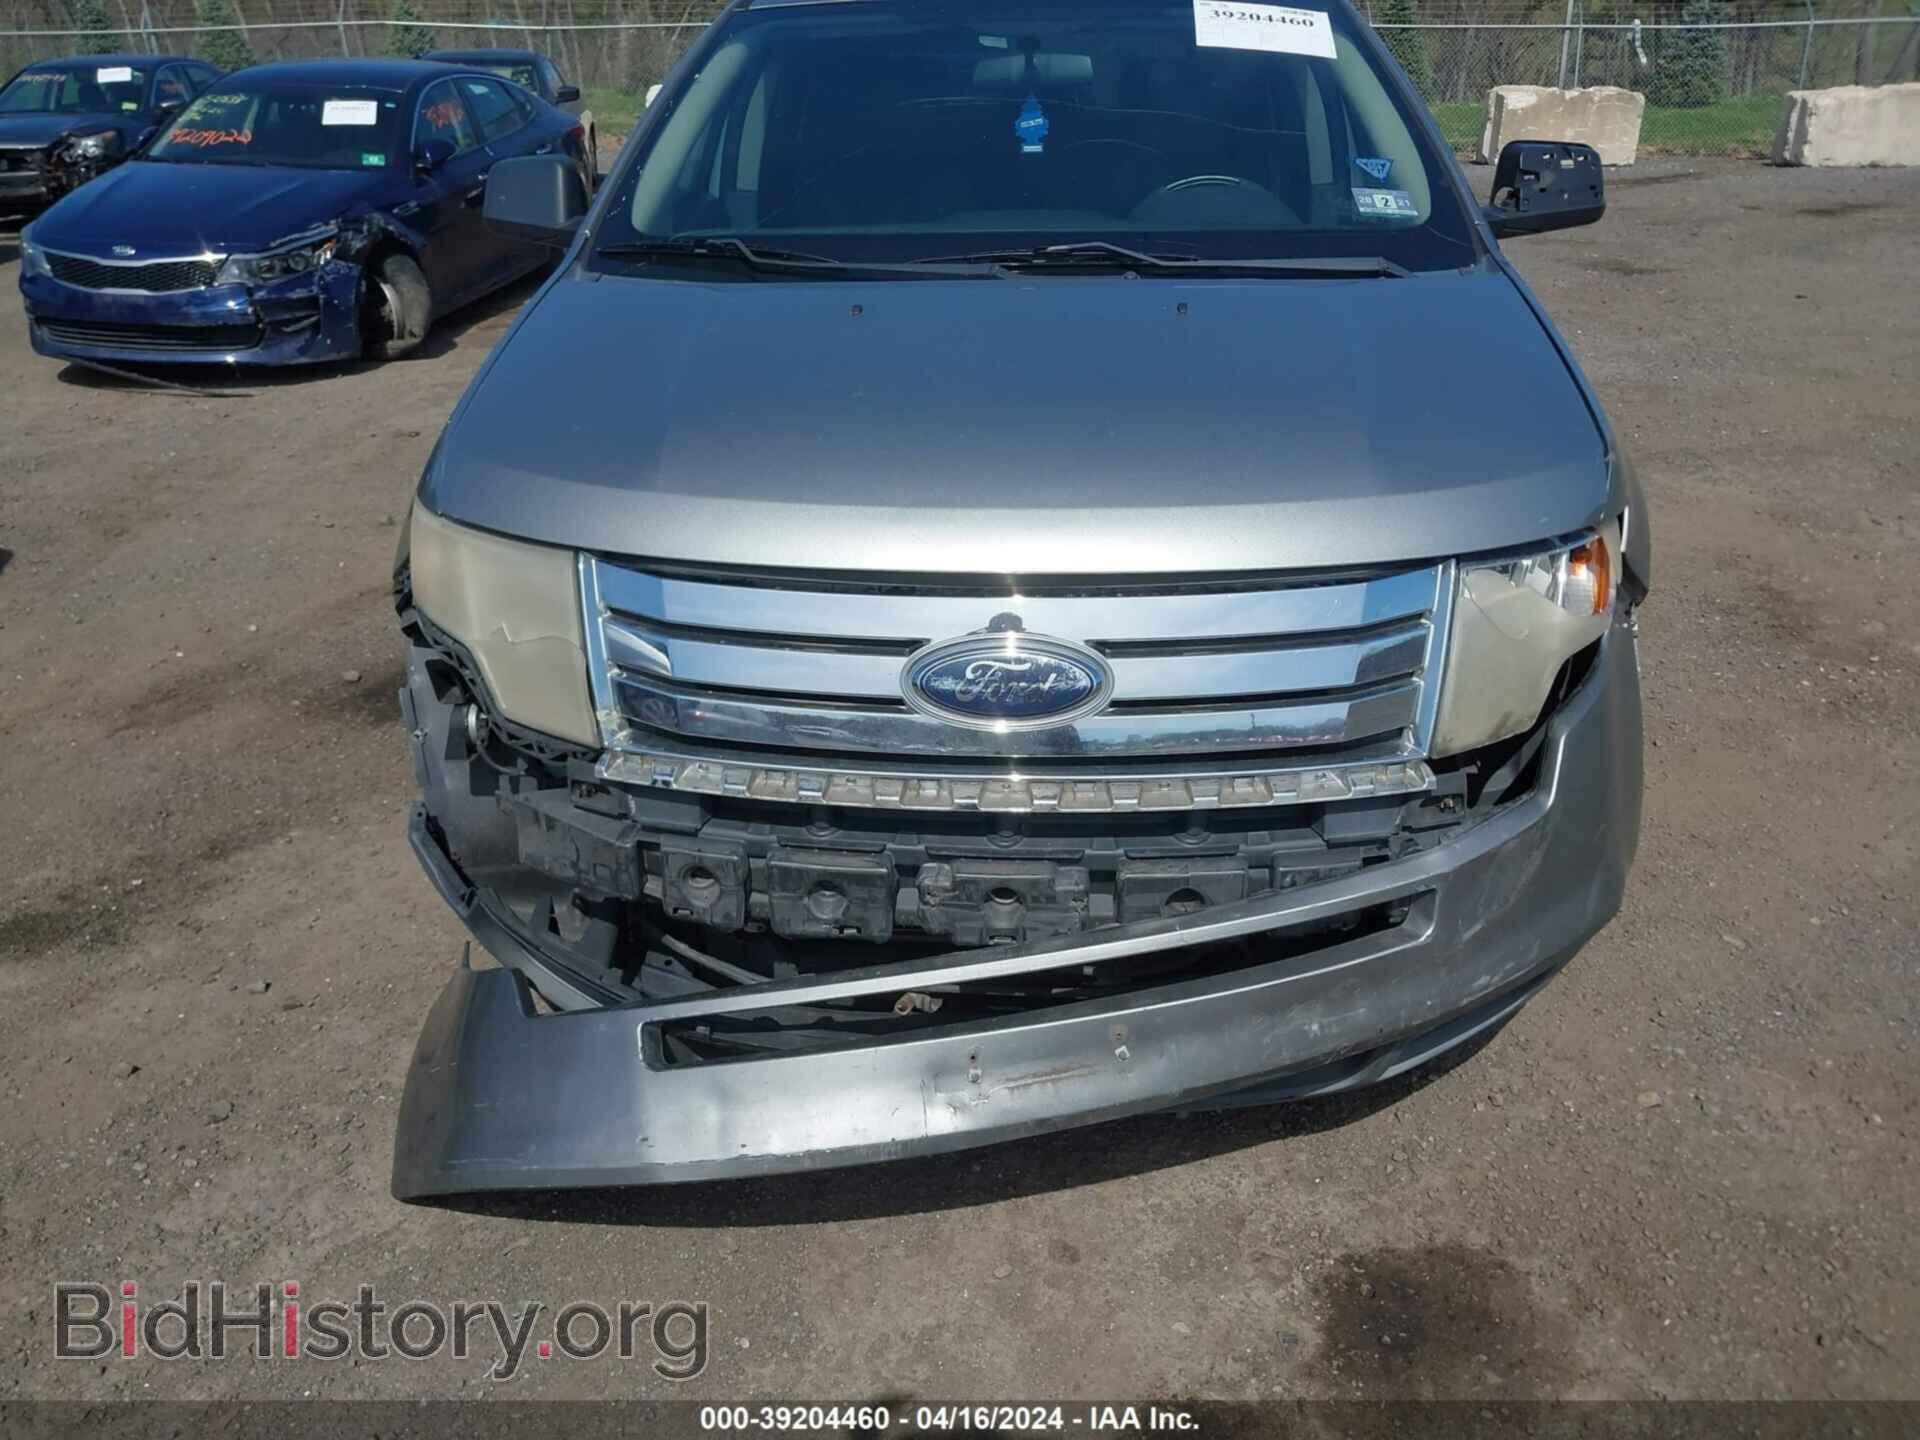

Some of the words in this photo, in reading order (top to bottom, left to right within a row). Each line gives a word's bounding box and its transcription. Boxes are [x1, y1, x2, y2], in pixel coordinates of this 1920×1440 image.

[1209, 8, 1315, 28] 39204460
[1380, 196, 1392, 207] 2
[955, 660, 1058, 702] Ford
